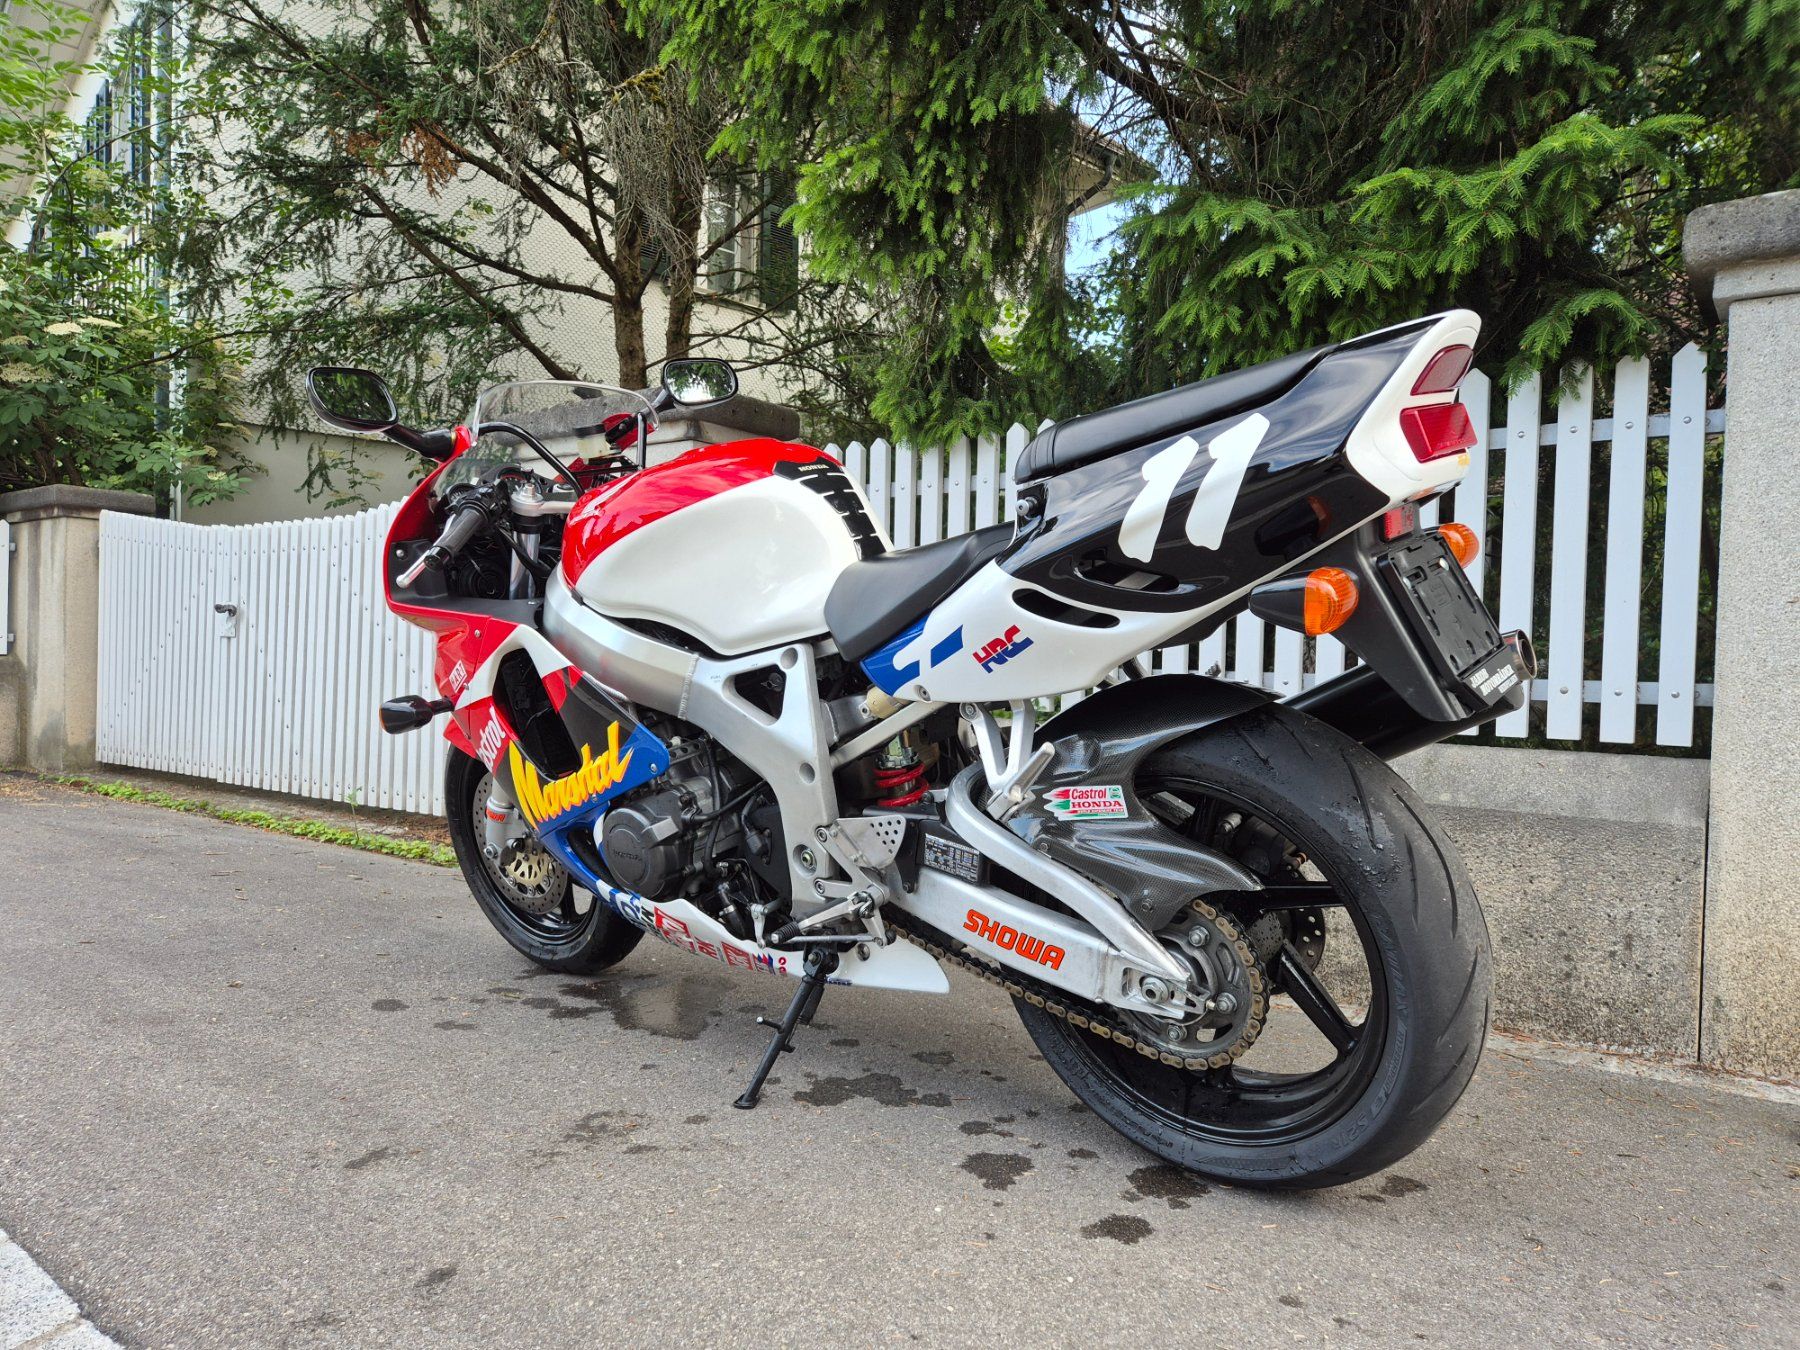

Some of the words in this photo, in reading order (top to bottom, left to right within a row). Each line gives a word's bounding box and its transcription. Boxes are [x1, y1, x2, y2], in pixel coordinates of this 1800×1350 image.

[1118, 412, 1270, 563] 11
[972, 624, 1034, 674] HRC
[475, 704, 507, 773] astrol
[1071, 787, 1107, 800] Castrol
[1071, 800, 1124, 809] HONDA
[962, 908, 1066, 971] SHOWA
